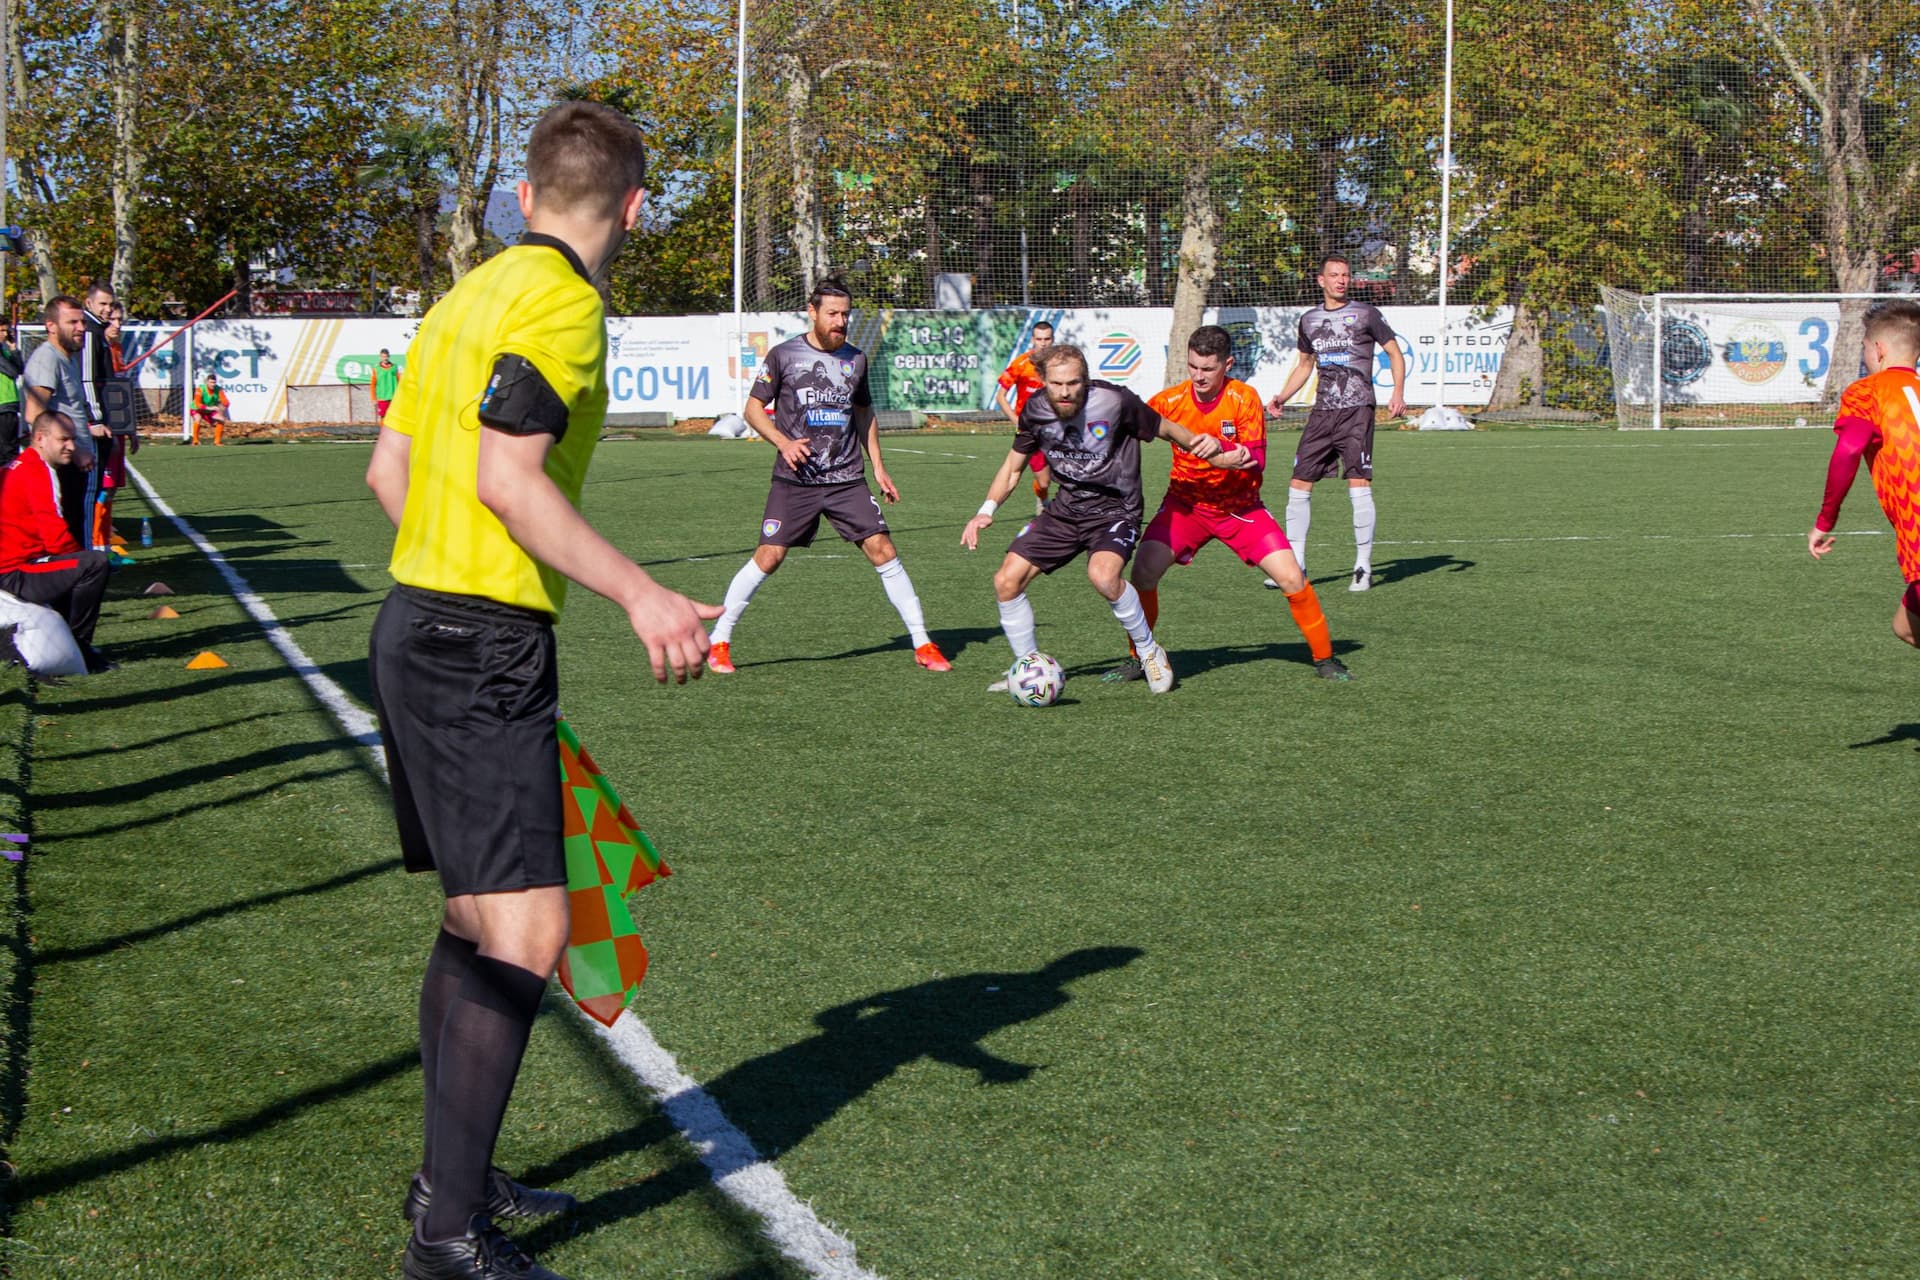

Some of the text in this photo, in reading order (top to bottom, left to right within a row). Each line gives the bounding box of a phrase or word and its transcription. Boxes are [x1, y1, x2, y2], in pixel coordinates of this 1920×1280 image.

[894, 351, 979, 373] сентября
[612, 366, 710, 401] СОЧИ
[924, 376, 971, 394] Сочи
